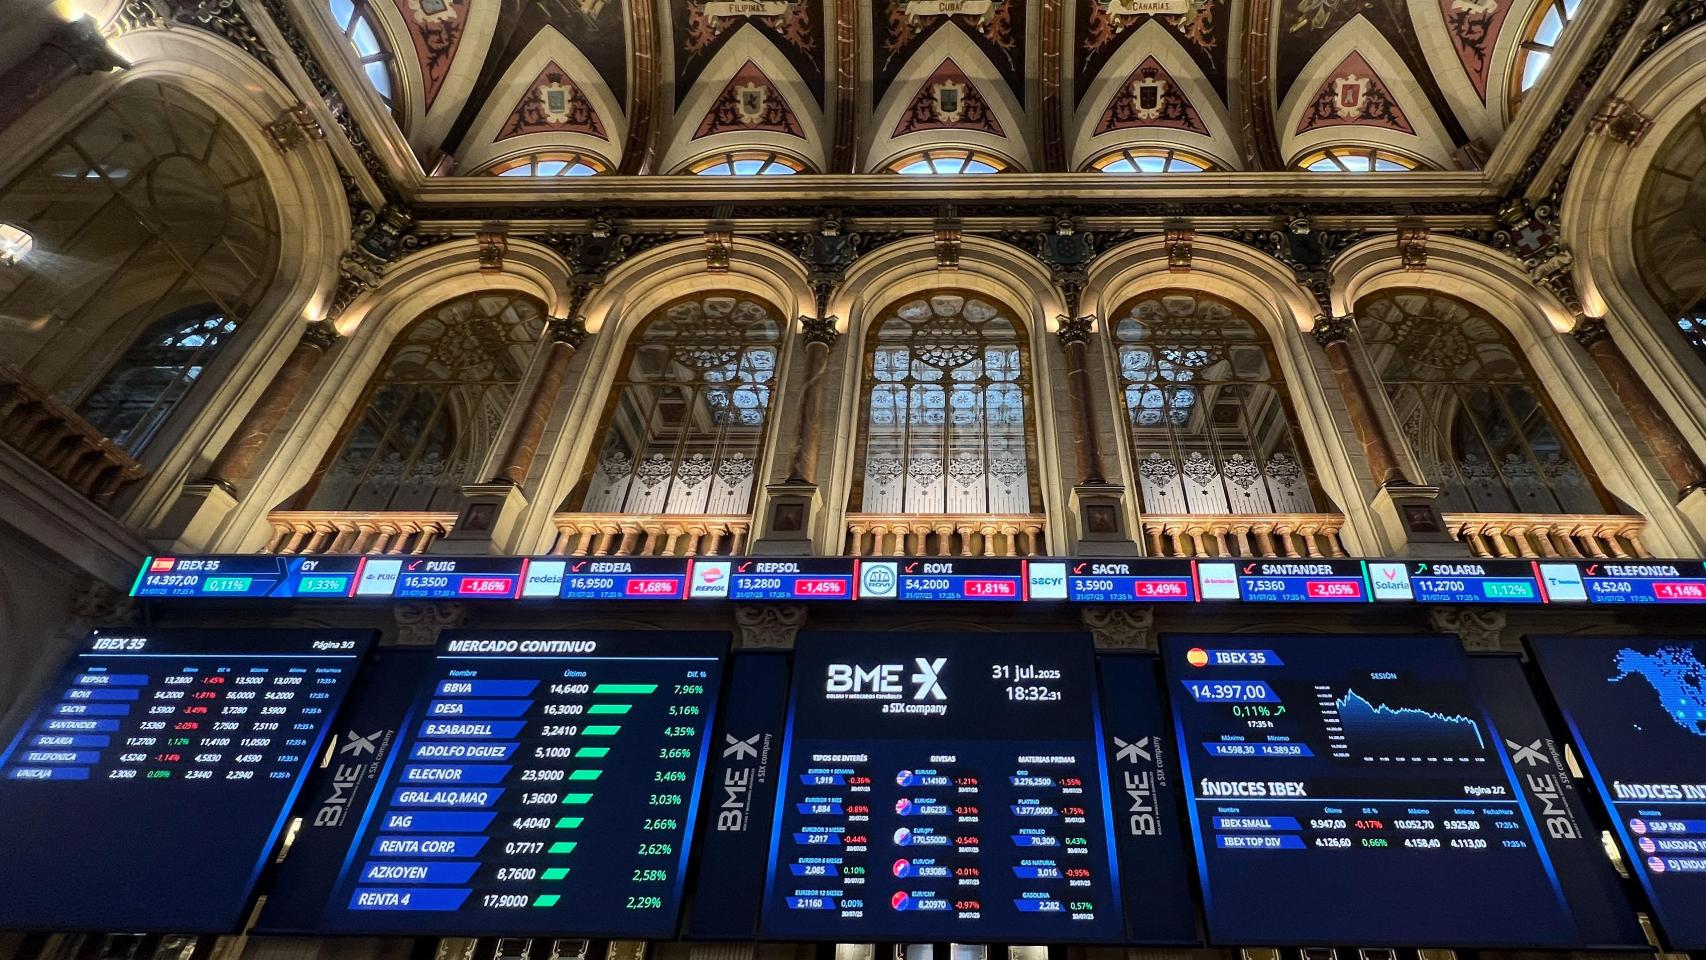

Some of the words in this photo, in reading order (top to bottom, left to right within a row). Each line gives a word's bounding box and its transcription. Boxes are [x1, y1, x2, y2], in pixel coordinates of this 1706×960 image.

[177, 561, 203, 570] IBEX
[204, 561, 220, 570] 35
[301, 561, 318, 571] GY
[426, 562, 456, 571] PUIG
[591, 562, 631, 573] REDEIA
[757, 563, 800, 573] REPSOL
[924, 564, 952, 573] ROVI
[1092, 564, 1129, 575] SACYR
[1262, 565, 1334, 575] SANTANDER
[1433, 565, 1485, 575] SOLARIA
[1604, 565, 1679, 576] TELEFONICA
[146, 576, 198, 586] 14.397,00
[210, 580, 244, 591] 0,11%
[404, 577, 448, 588] 16,3500
[466, 581, 505, 592] -1,86%
[529, 574, 561, 584] redeia
[1032, 578, 1064, 586] sacyr
[306, 580, 340, 590] 1,33%
[571, 578, 614, 590] 16,9500
[634, 582, 672, 593] -1,68%
[738, 579, 781, 590] 13,2800
[802, 582, 840, 593] -1,45%
[906, 580, 950, 591] 54,2000
[971, 583, 1010, 594] -1,81%
[1076, 580, 1113, 592] 3,5900
[1142, 584, 1180, 594] -3,49%
[1247, 581, 1285, 592] 7,5360
[1314, 584, 1354, 595] -2,05%
[1376, 581, 1409, 589] Solaria
[1420, 581, 1464, 591] 11,2700
[1491, 585, 1526, 595] 1,12%
[1593, 582, 1631, 593] 4,5240
[1661, 586, 1703, 596] -1,14%
[93, 638, 127, 649] IBEX
[128, 638, 146, 649] 35
[313, 640, 340, 650] Página
[341, 641, 355, 649] 3/3
[449, 641, 517, 652] MERCADO
[520, 641, 597, 653] CONTINUO
[1216, 653, 1247, 663] IBEX
[1249, 653, 1266, 663] 35
[827, 664, 903, 692] BME
[992, 665, 1009, 680] 31
[1014, 664, 1060, 682] jul.2025
[1371, 672, 1397, 680] SESIÓN
[81, 676, 109, 684] REPSOL
[443, 683, 472, 693] BBVA
[550, 683, 589, 694] 14,6400
[674, 684, 704, 695] 7,96%
[1006, 687, 1061, 701] 18:32:31
[1192, 685, 1265, 700] 14.397,00
[60, 705, 85, 713] SACYR
[435, 704, 464, 714] DESA
[544, 704, 583, 716] 16,3000
[669, 705, 699, 716] 5,16%
[890, 703, 905, 712] SIX
[906, 703, 947, 715] company
[1233, 706, 1270, 717] 0,11%
[50, 721, 97, 729] SANTANDER
[427, 724, 492, 735] B.SABADELL
[542, 725, 577, 736] 3,2410
[664, 726, 695, 738] 4,35%
[39, 737, 73, 745] SOLARIA
[417, 746, 464, 757] ADOLFO
[466, 747, 506, 757] DGUEZ
[535, 747, 571, 759] 5,1000
[659, 748, 691, 759] 3,66%
[1217, 746, 1254, 755] 14.598,30
[1263, 746, 1301, 755] 14.389,50
[29, 753, 76, 761] TELEFONICA
[16, 770, 51, 778] UNICAJA
[408, 768, 462, 780] ELECNOR
[522, 769, 564, 782] 23,9000
[655, 771, 686, 782] 3,46%
[1014, 778, 1051, 786] 3.276,2500
[1201, 778, 1266, 795] ÍNDICES
[1268, 782, 1306, 796] IBEX
[313, 764, 361, 826] BME
[1464, 786, 1491, 796] Página
[400, 792, 488, 805] GRAL.ALQ.MAQ
[522, 793, 557, 805] 1,3600
[649, 794, 682, 806] 3,03%
[717, 768, 749, 831] BME
[1125, 771, 1155, 835] BME
[1016, 807, 1053, 815] 1.377,0000
[1527, 774, 1577, 839] BME
[389, 816, 413, 827] IAG
[513, 817, 550, 830] 4,4040
[644, 818, 677, 831] 2,66%
[1221, 819, 1241, 827] IBEX
[1242, 819, 1271, 827] SMALL
[1311, 820, 1346, 829] 9.947,00
[1355, 821, 1383, 829] -0,17%
[1394, 821, 1435, 830] 10.052,70
[1669, 823, 1685, 831] 500
[809, 835, 828, 843] 2,017
[913, 836, 946, 844] 170,55000
[1032, 837, 1055, 845] 70,300
[1224, 838, 1246, 846] IBEX
[1247, 838, 1263, 846] TOP
[1266, 838, 1281, 846] DIV
[1316, 838, 1351, 848] 4.126,60
[1451, 839, 1486, 849] 4.113,00
[380, 841, 420, 852] RENTA
[422, 841, 455, 853] CORP.
[506, 842, 544, 855] 0,7717
[639, 843, 672, 856] 2,62%
[1659, 841, 1698, 851] NASDAQ
[369, 867, 427, 879] AZKOYEN
[497, 868, 536, 881] 8,7600
[633, 869, 667, 882] 2,58%
[1038, 869, 1057, 877] 3,016
[359, 893, 399, 906] RENTA
[401, 894, 410, 906] 4
[483, 894, 528, 909] 17,9000
[627, 896, 661, 909] 2,29%
[798, 899, 822, 908] 2,1160
